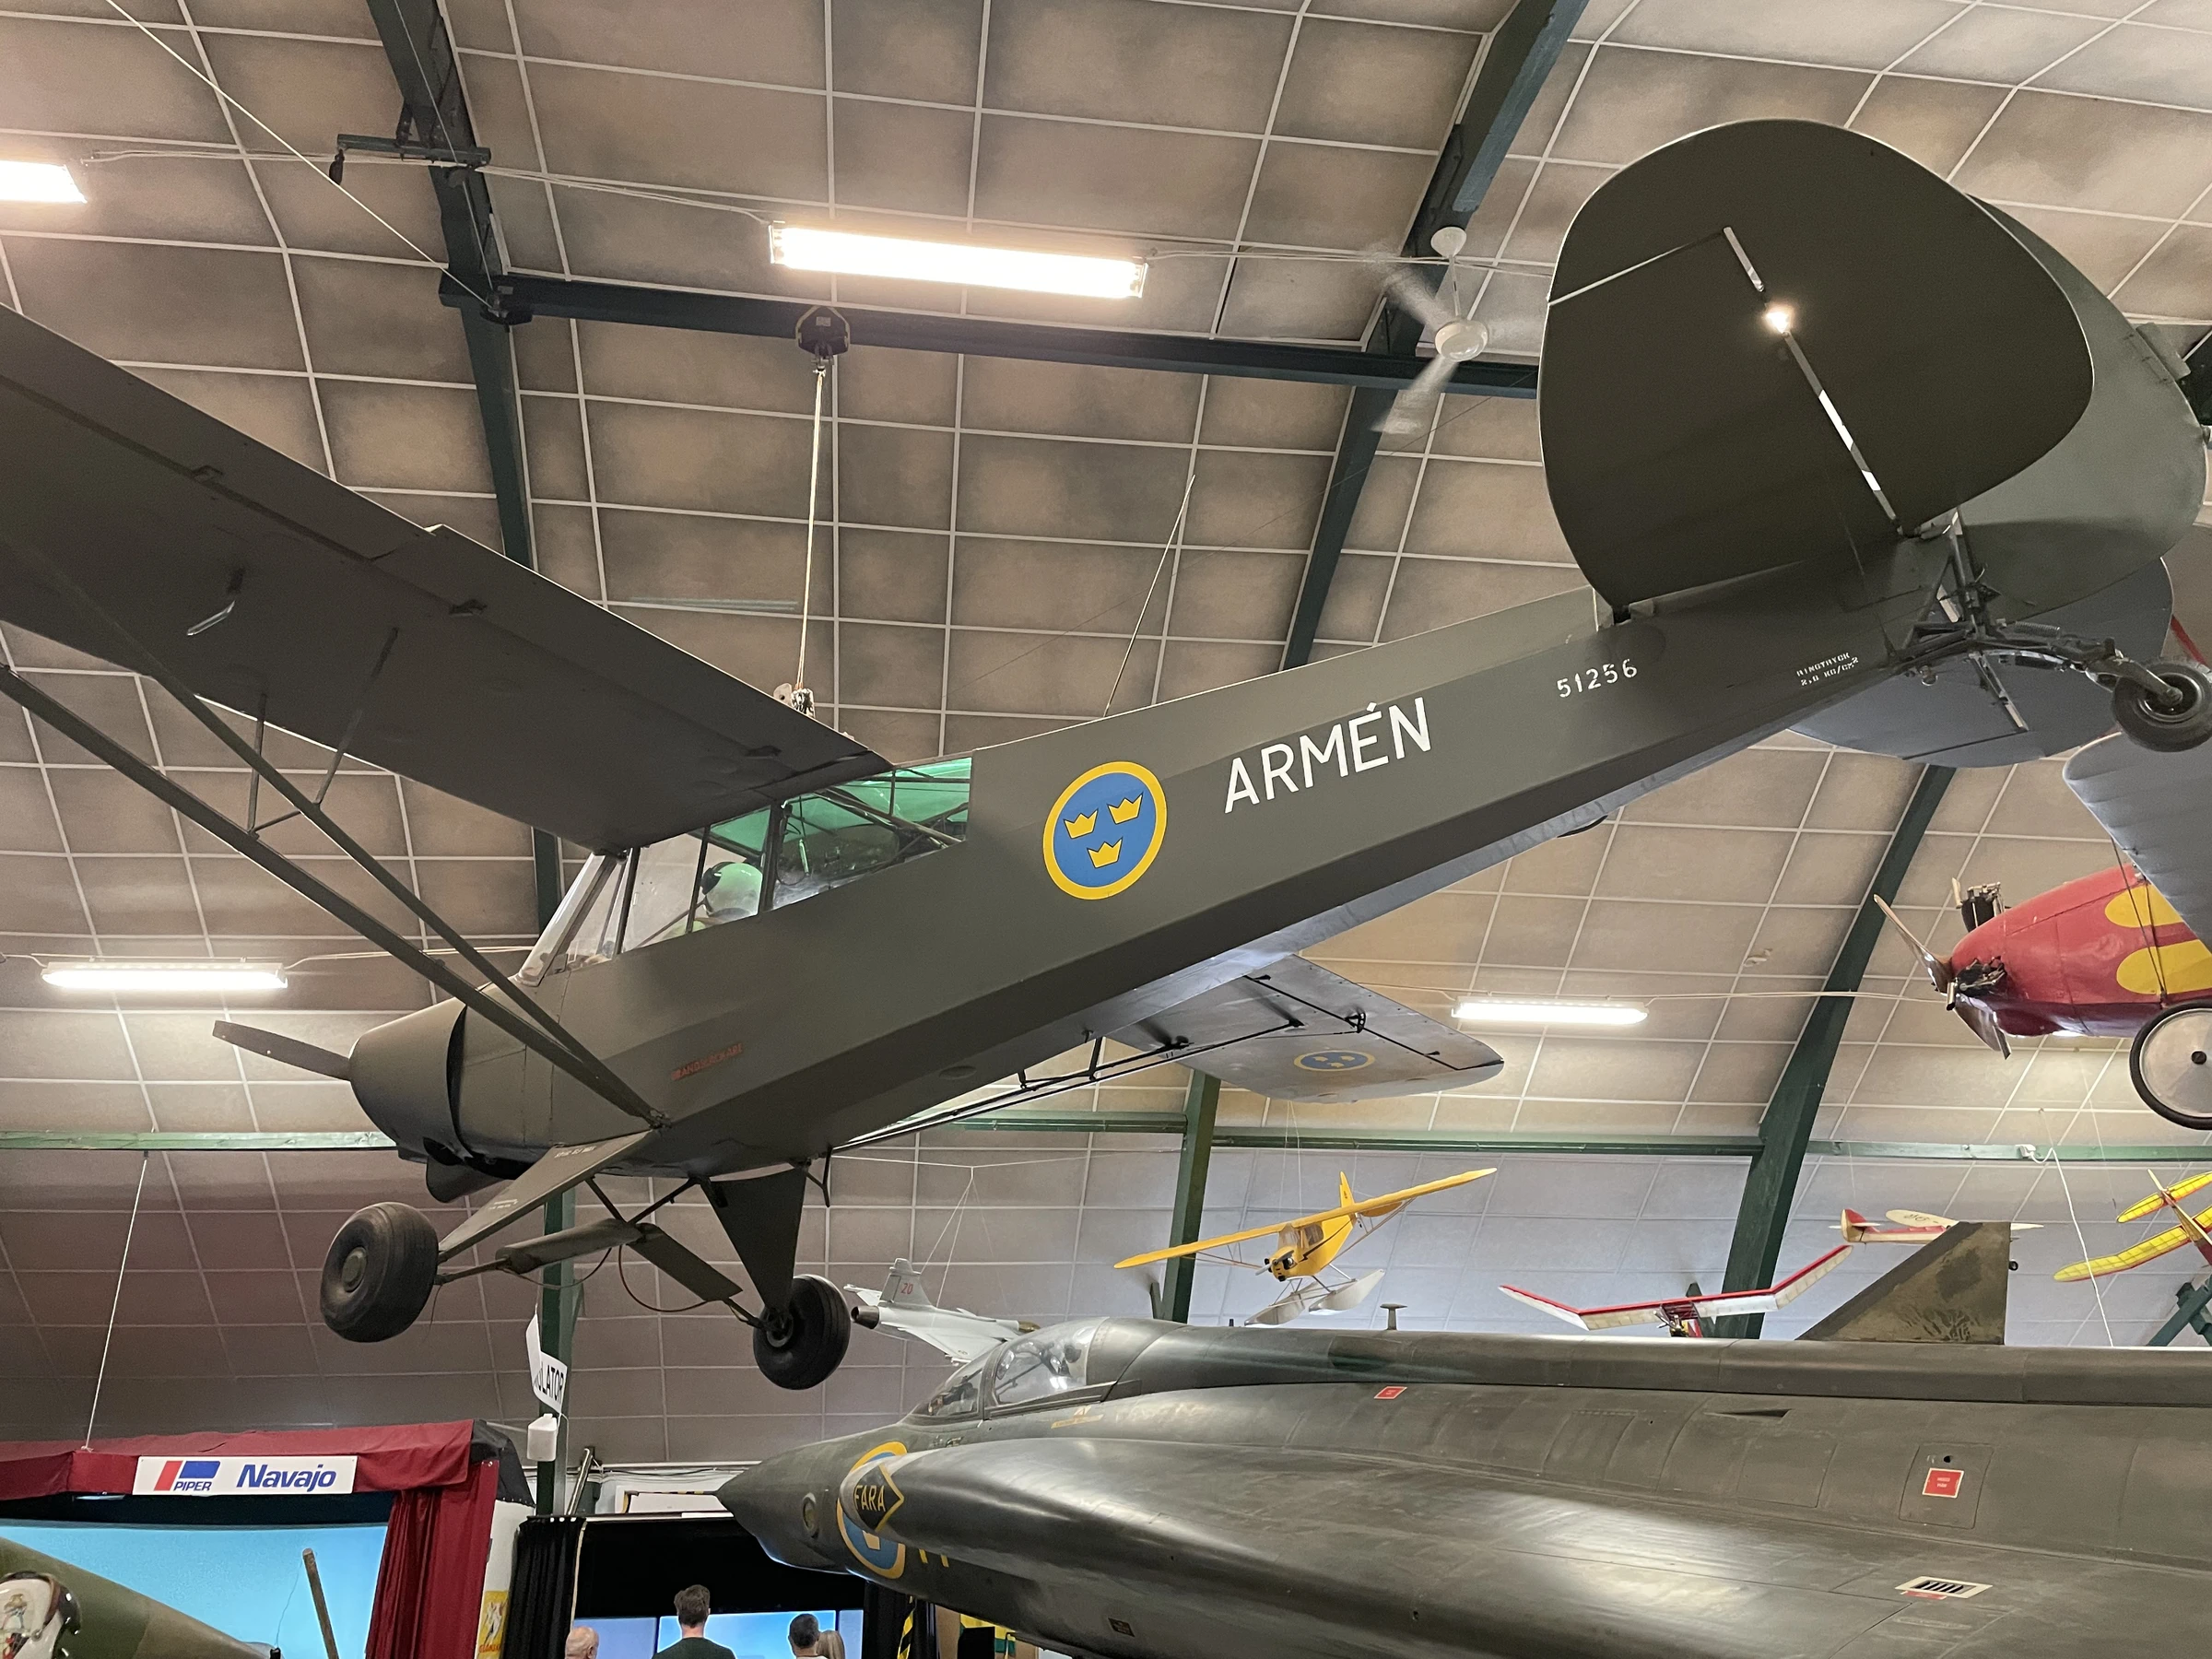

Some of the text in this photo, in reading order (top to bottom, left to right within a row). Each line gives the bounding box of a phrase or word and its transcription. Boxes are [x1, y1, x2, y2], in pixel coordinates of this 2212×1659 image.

[1556, 658, 1638, 698] 51256
[1796, 652, 1851, 677] RINGTRYCK
[1224, 697, 1432, 814] ARMÉN
[900, 1282, 914, 1295] 20
[173, 1481, 213, 1491] PIPER
[236, 1464, 337, 1492] Navajo
[853, 1484, 887, 1512] FARA
